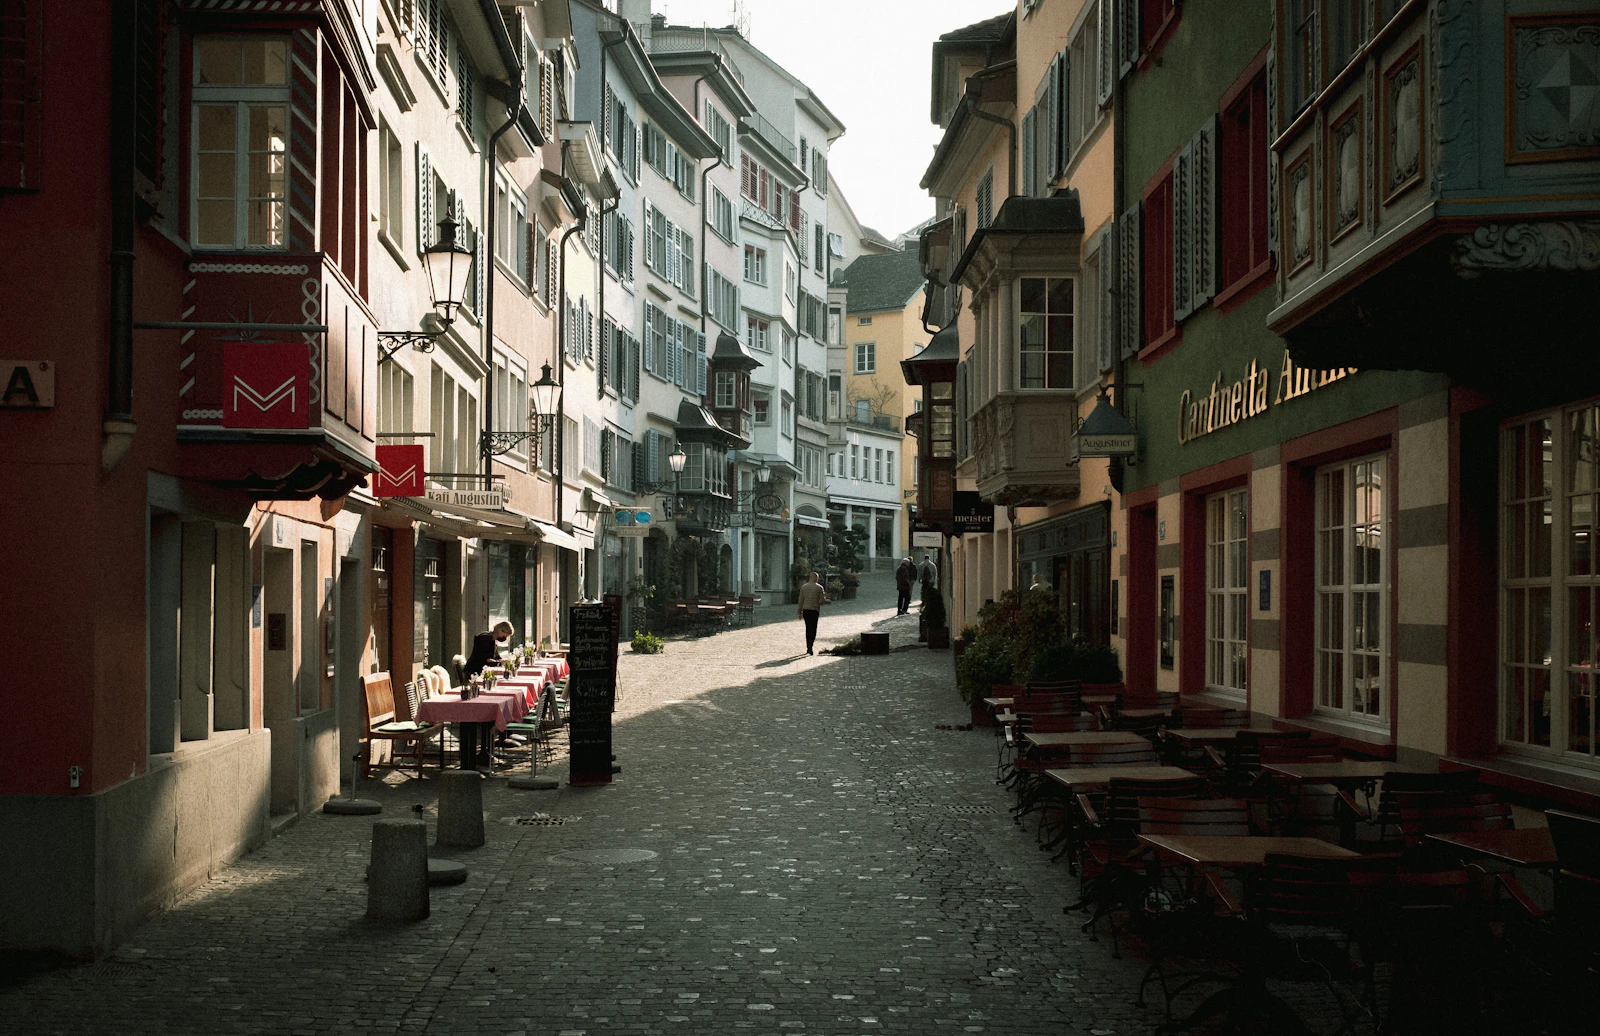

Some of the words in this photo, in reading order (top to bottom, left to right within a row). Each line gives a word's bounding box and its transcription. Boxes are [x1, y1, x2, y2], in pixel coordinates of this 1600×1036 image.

[2, 366, 39, 401] A
[1177, 357, 1269, 445] Cantinetta
[1082, 438, 1132, 450] Augustiner
[454, 492, 500, 506] Augustin
[954, 514, 992, 523] meister
